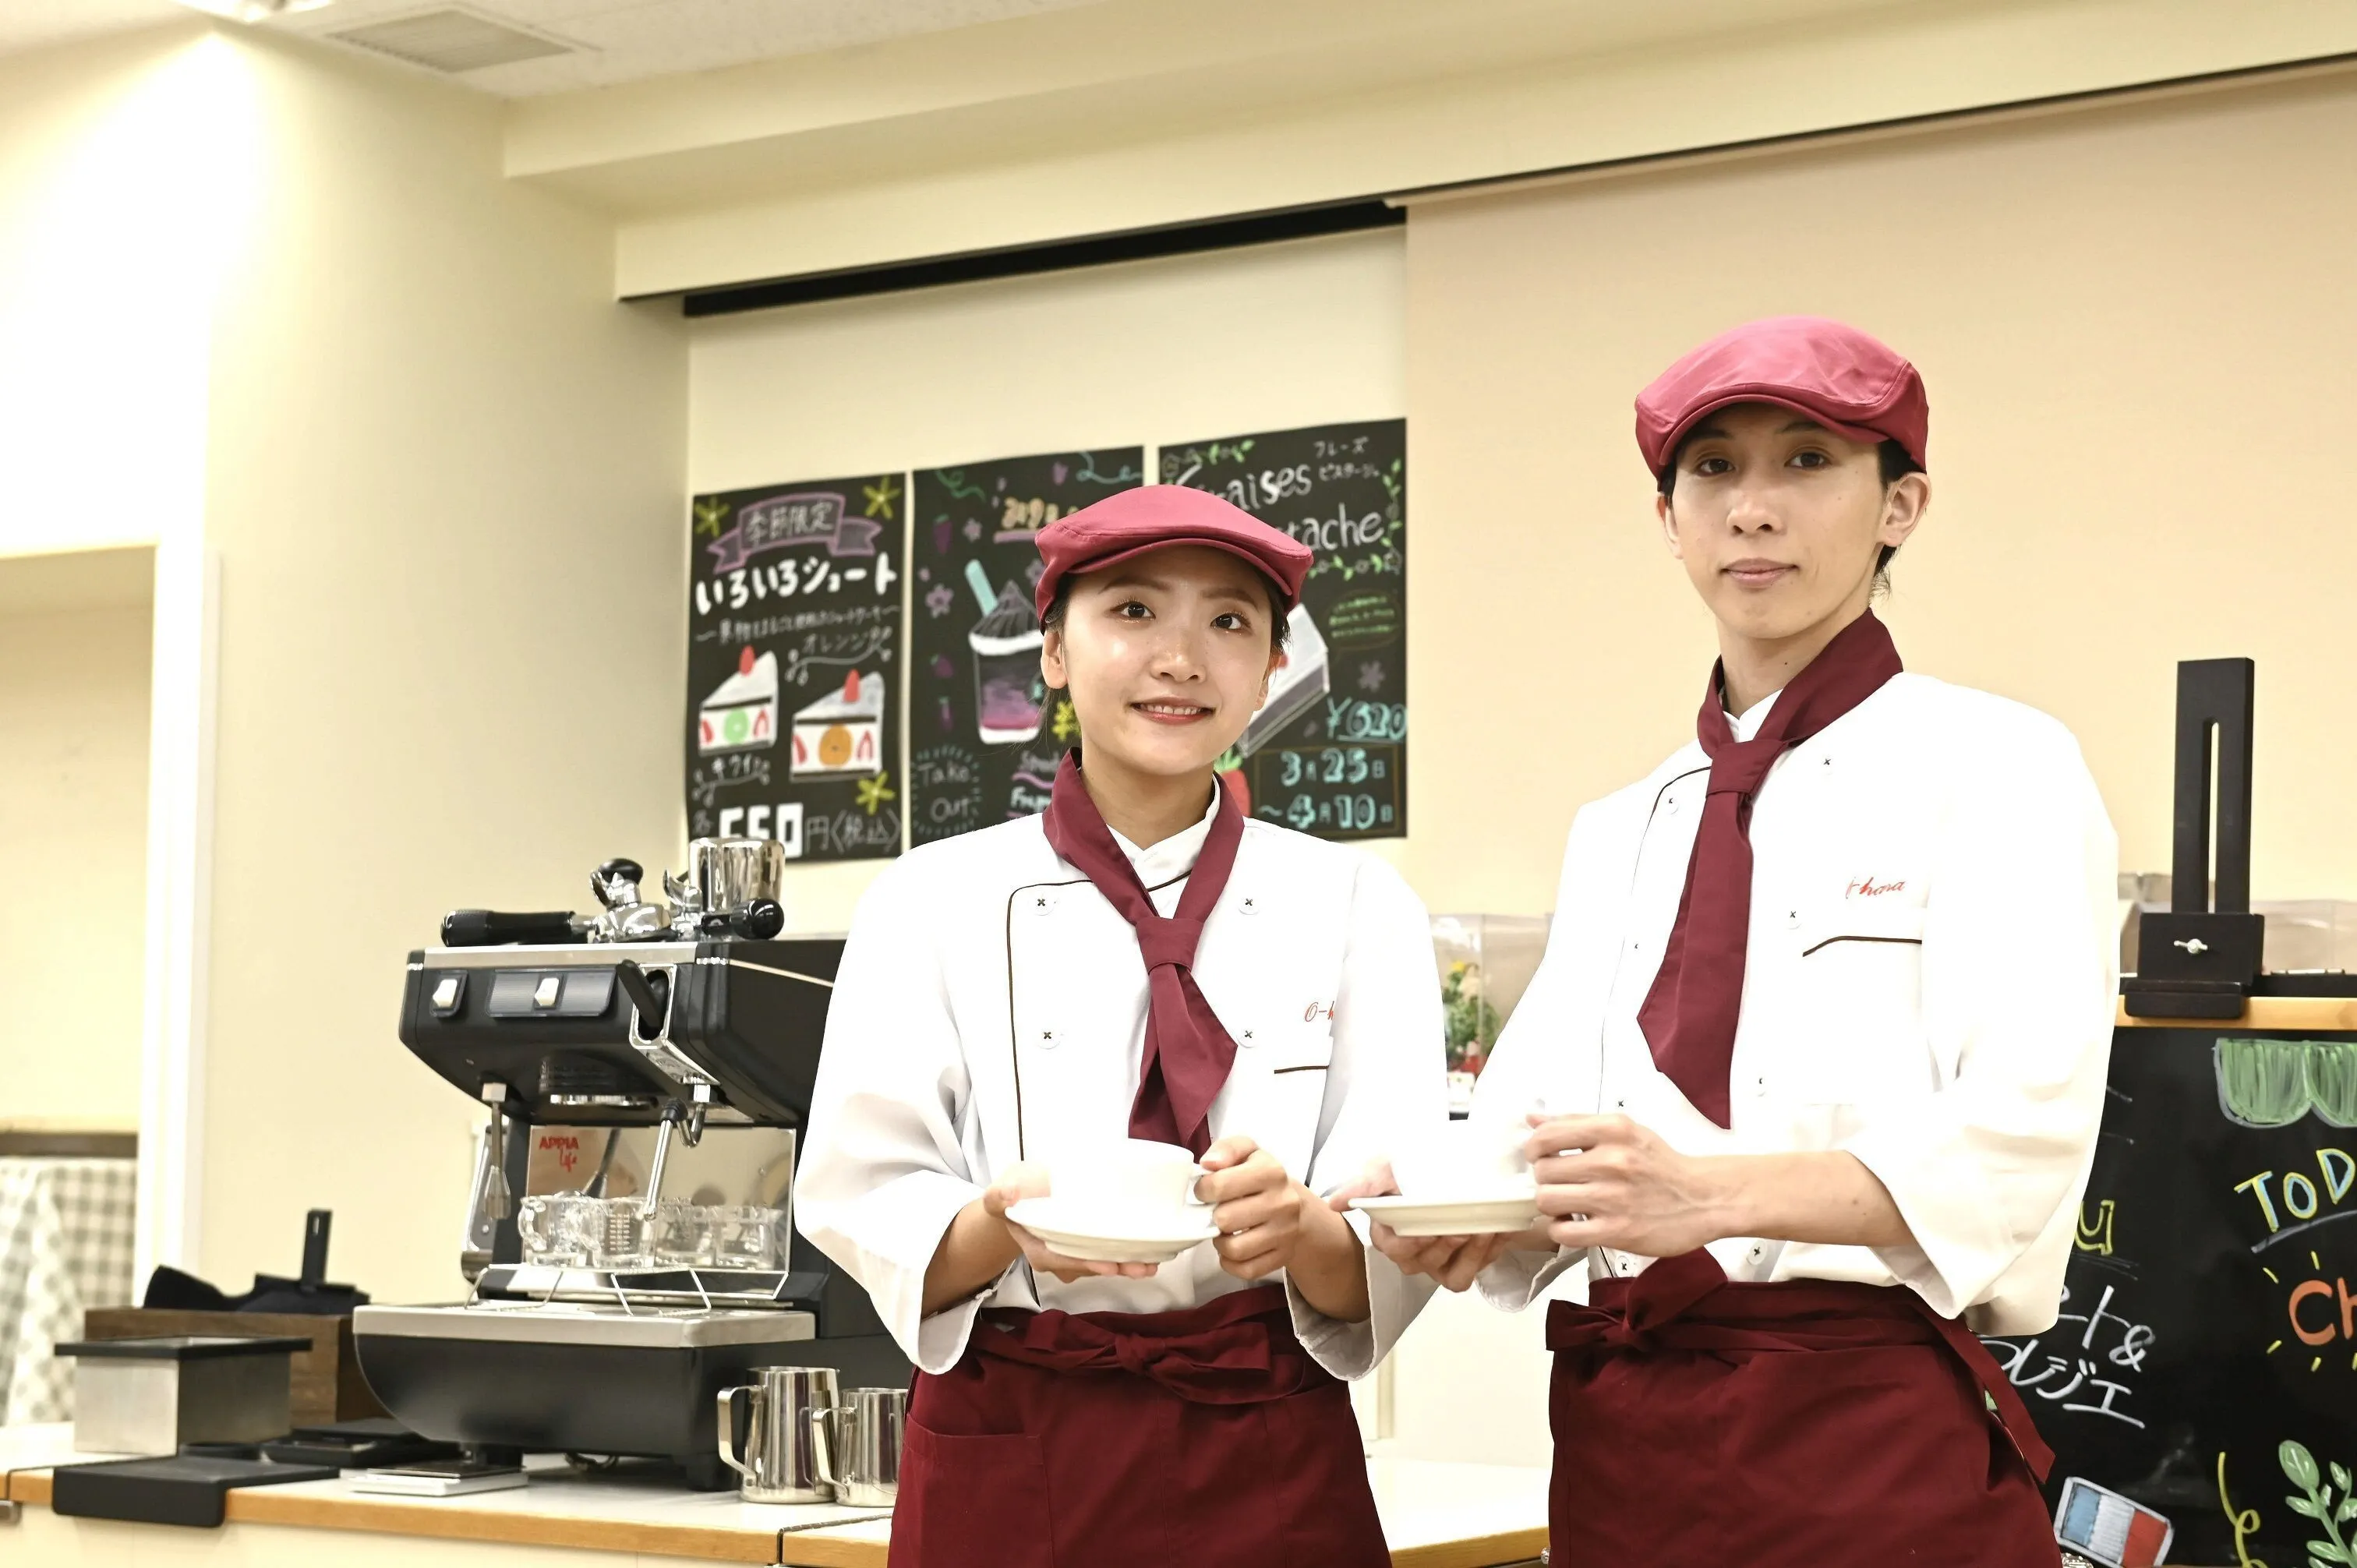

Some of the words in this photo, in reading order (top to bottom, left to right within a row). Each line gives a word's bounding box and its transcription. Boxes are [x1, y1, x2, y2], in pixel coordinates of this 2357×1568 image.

[695, 552, 897, 615] いろいろショート
[1281, 747, 1386, 787] 3月25日
[539, 1135, 579, 1150] APPIA
